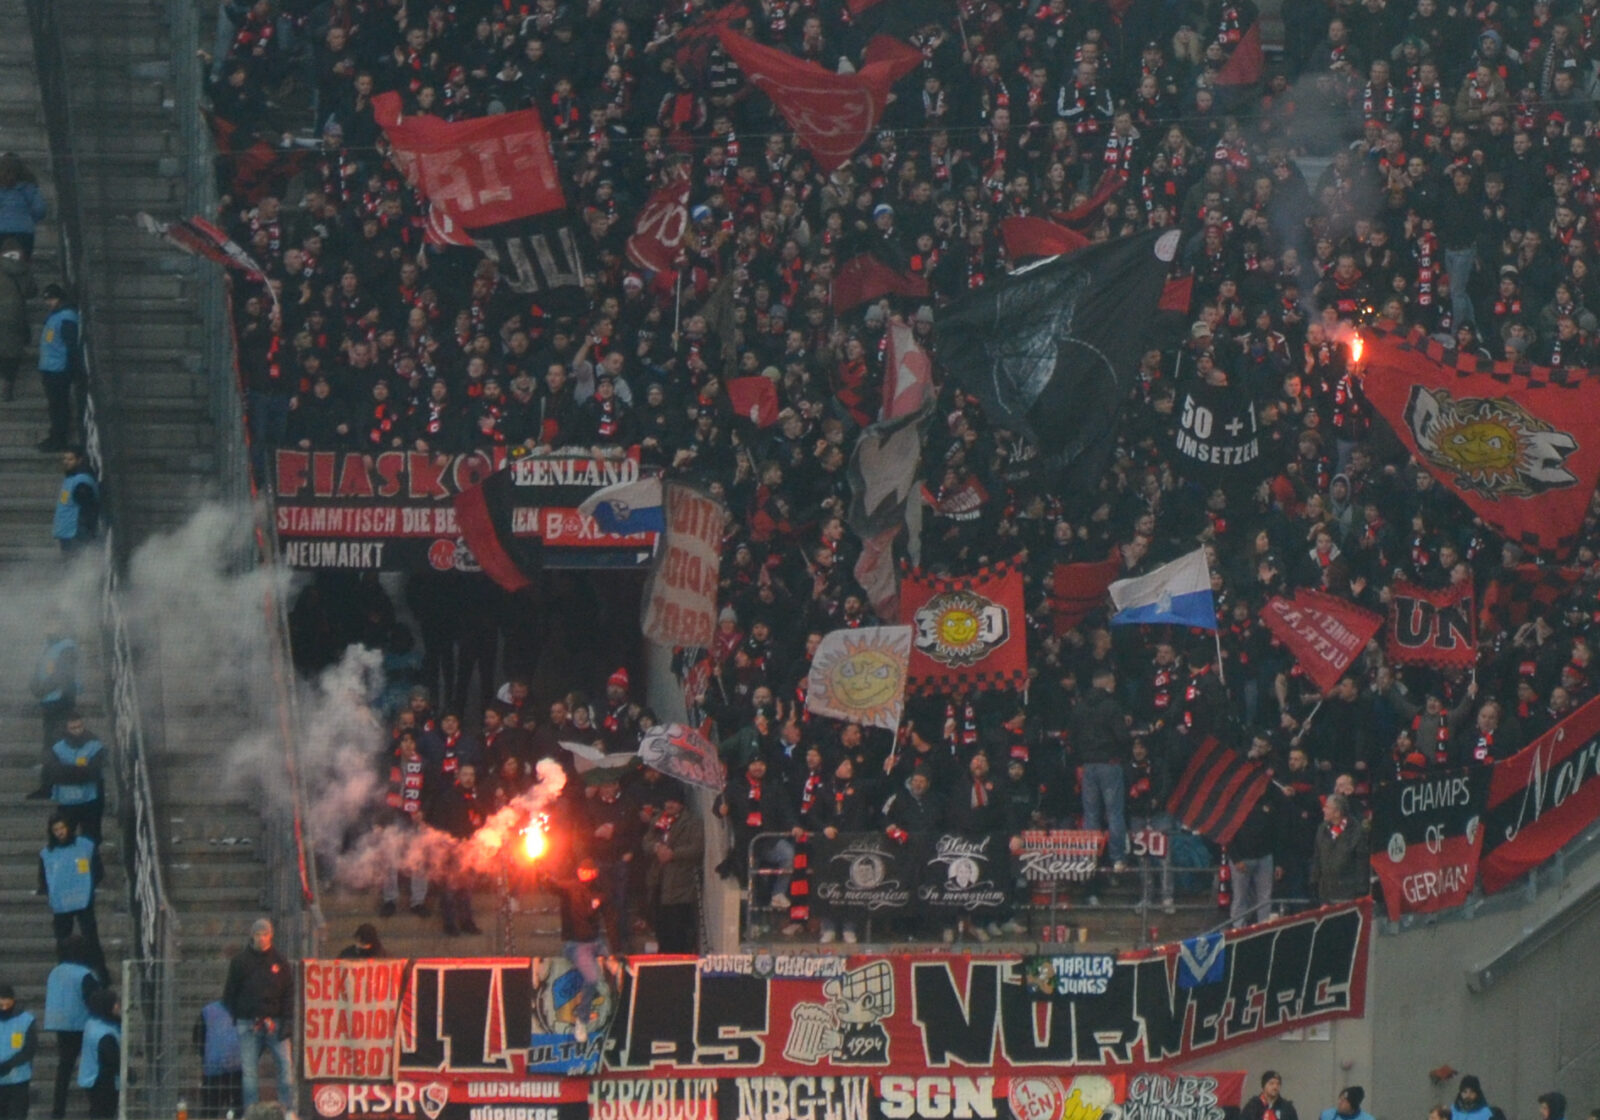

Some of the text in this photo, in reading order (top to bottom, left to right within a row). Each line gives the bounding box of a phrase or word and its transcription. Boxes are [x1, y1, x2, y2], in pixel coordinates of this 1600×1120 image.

[1181, 394, 1257, 439] 50 + 1
[1176, 429, 1259, 465] UMSETZEN
[276, 449, 491, 500] FIASKO
[511, 458, 639, 486] EENLAND
[277, 506, 397, 533] STAMMTISCH
[402, 508, 431, 533] DIE
[286, 541, 384, 568] NEUMARKT
[1394, 595, 1475, 650] UN
[1400, 777, 1470, 816] CHAMPS
[1425, 823, 1445, 854] OF
[703, 954, 847, 976] JUNGE CHAOTEN
[1053, 956, 1114, 977] MARLER
[1058, 977, 1109, 995] JUNGS
[847, 1037, 884, 1057] 1994
[347, 1081, 416, 1114] RSR
[880, 1077, 997, 1119] SGN
